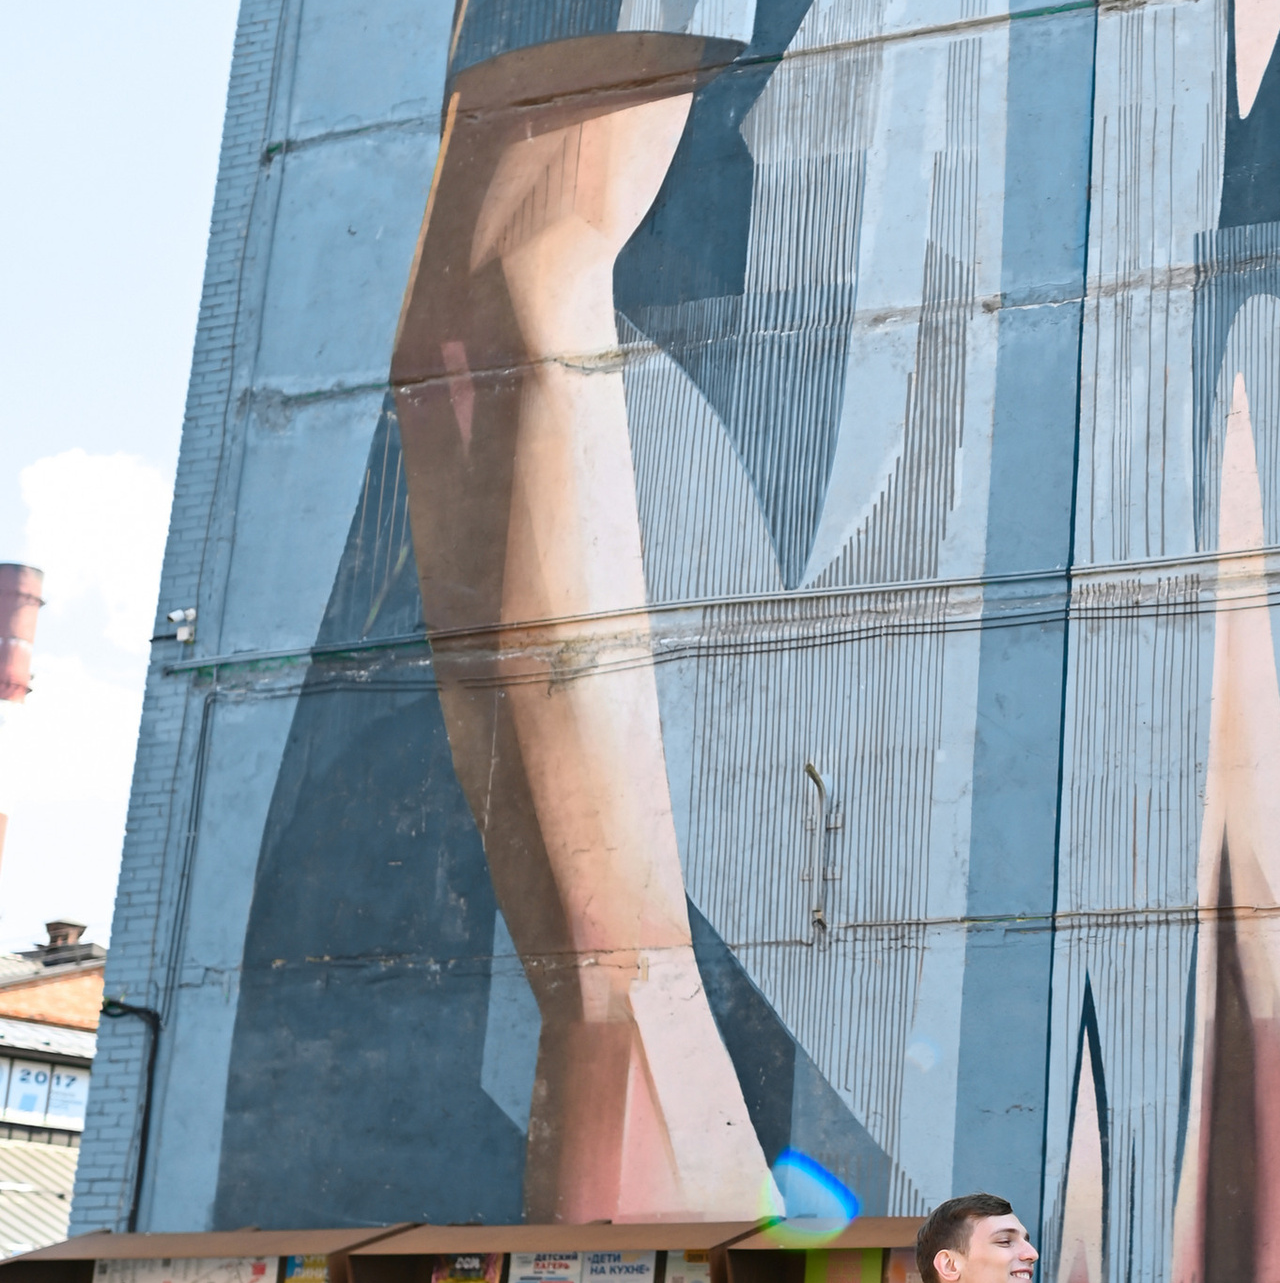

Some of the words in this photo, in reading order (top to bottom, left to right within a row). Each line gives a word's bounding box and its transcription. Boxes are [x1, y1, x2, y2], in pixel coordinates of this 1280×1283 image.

[19, 1069, 77, 1088] 2017
[533, 1252, 578, 1262] ДЕТСКИЙ
[533, 1261, 571, 1270] ЛАГЕРЬ
[590, 1265, 607, 1275] НА
